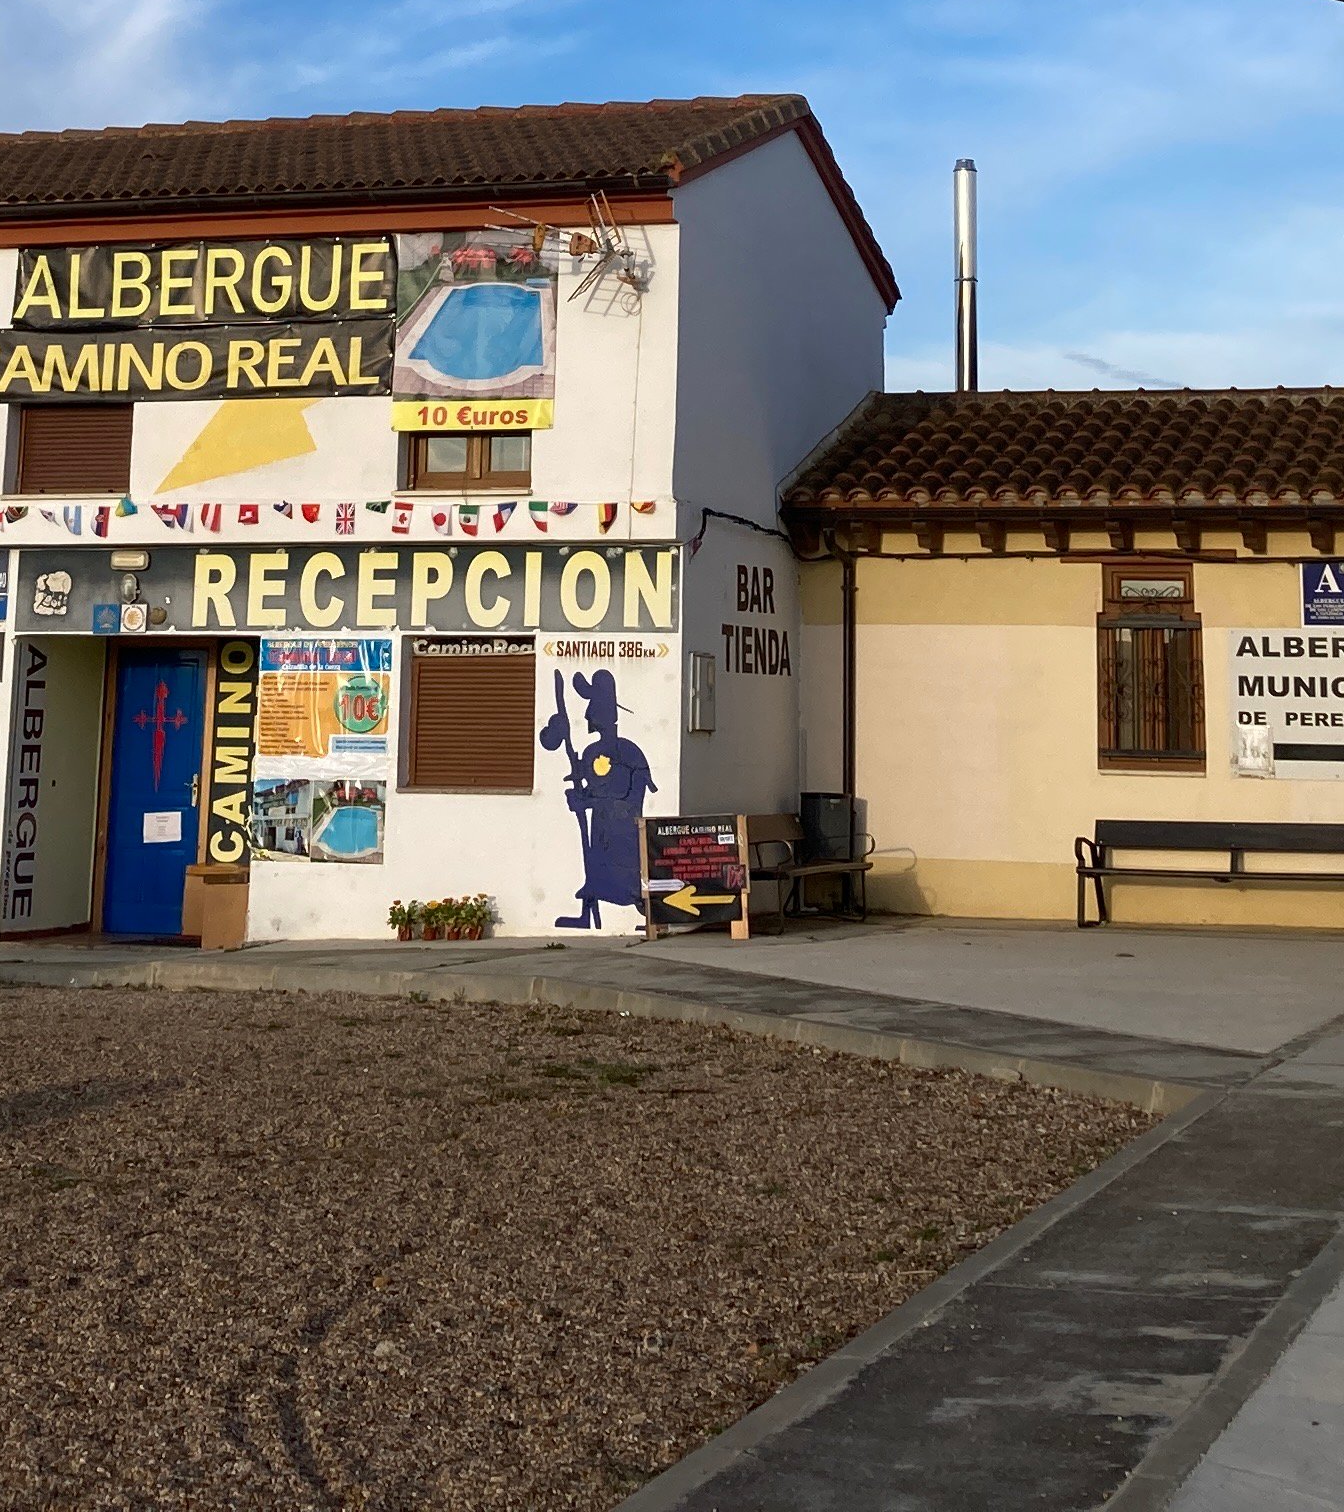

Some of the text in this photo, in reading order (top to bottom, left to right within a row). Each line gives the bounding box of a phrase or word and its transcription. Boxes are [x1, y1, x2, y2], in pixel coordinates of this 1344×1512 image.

[13, 242, 391, 320] ALBERGUE
[227, 337, 380, 389] REAL
[417, 406, 529, 427] 10 €uros
[192, 551, 672, 628] RECEPCION
[737, 564, 776, 614] BAR
[1314, 563, 1343, 593] A
[556, 641, 615, 658] SANTIAGO
[722, 623, 792, 677] TIENDA
[340, 694, 379, 721] 10€
[1238, 711, 1267, 726] DE
[210, 641, 254, 862] CAMINO
[11, 644, 48, 920] ALBERGUE
[657, 825, 690, 835] ALBERGUE
